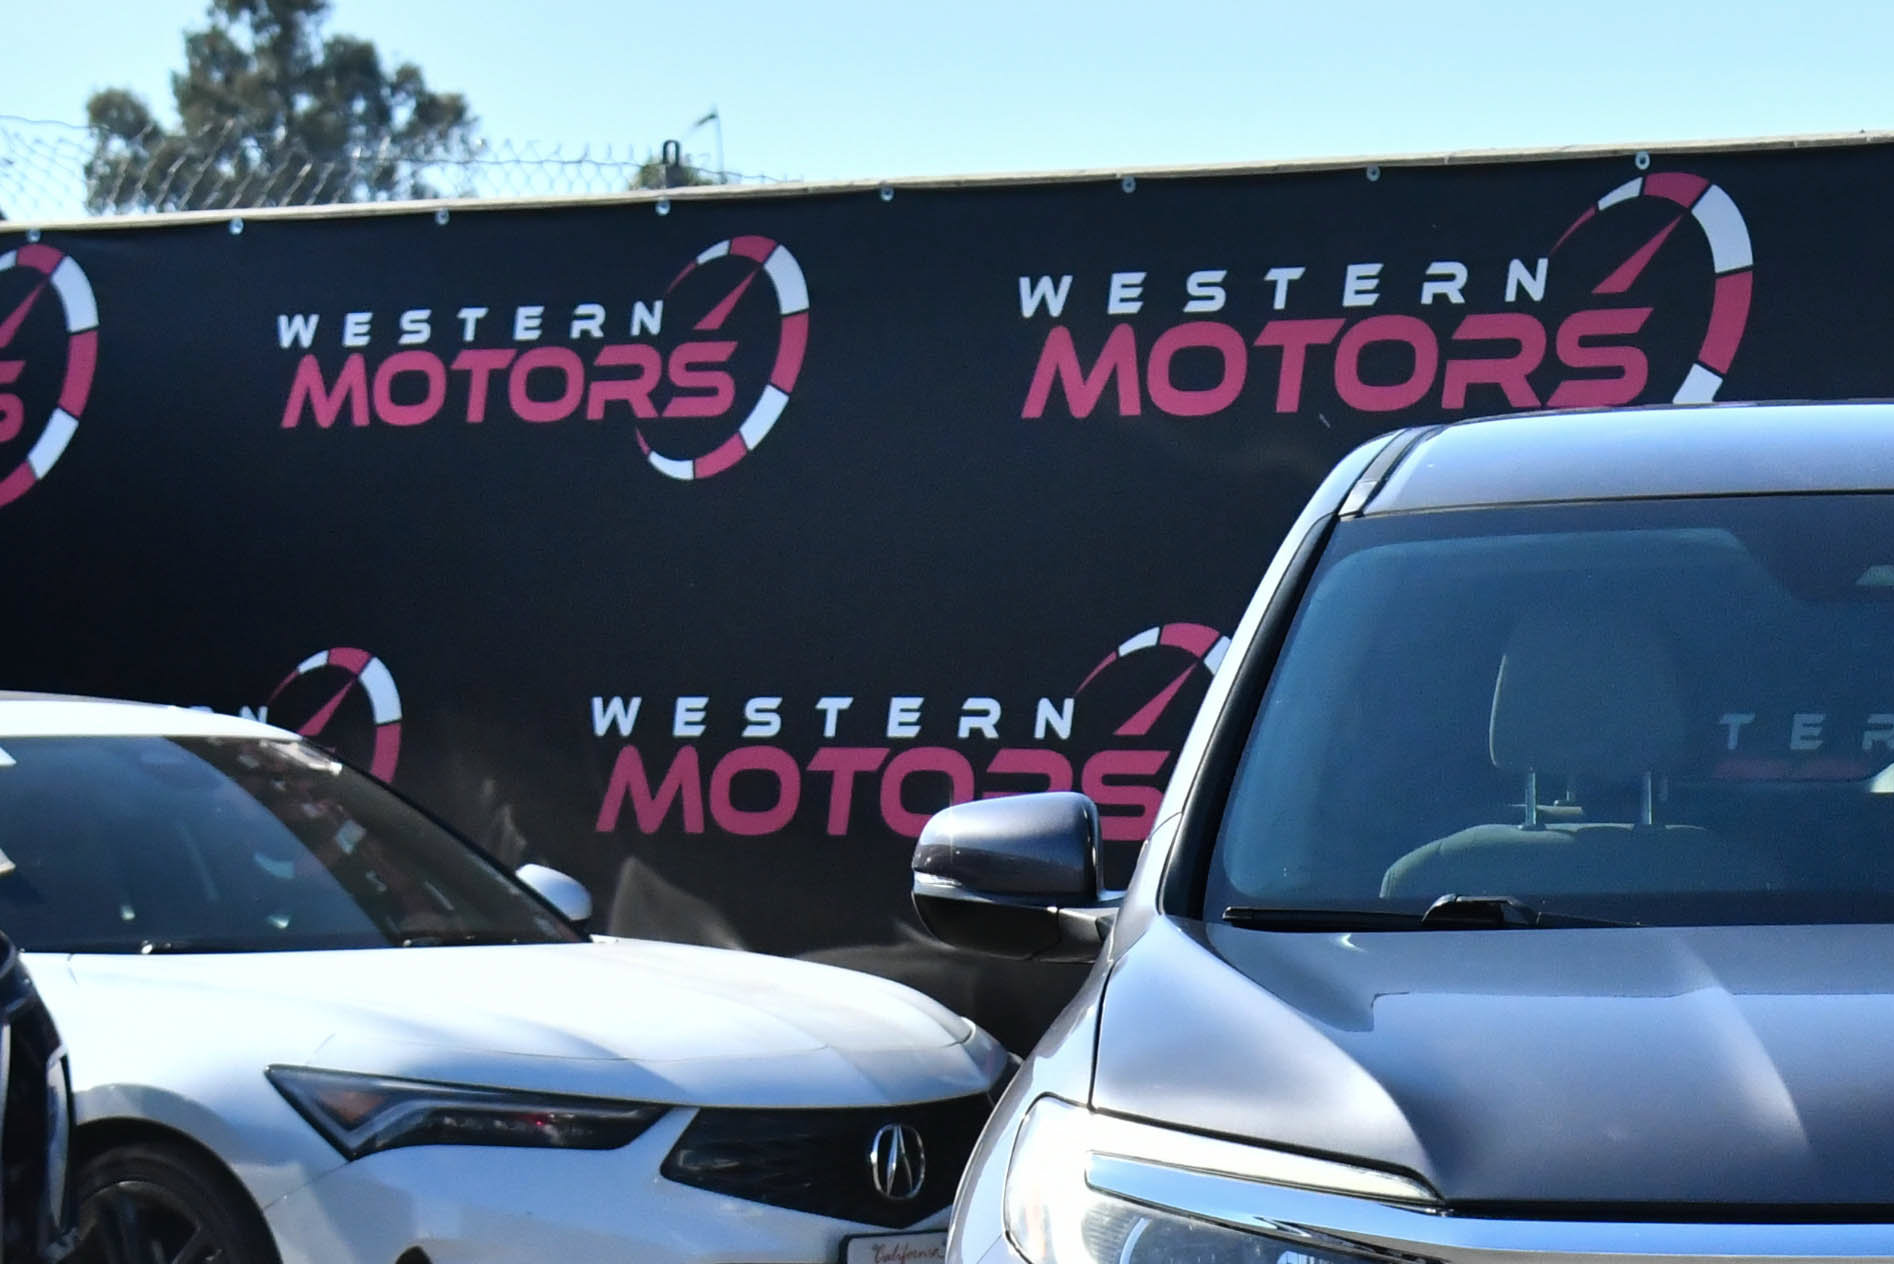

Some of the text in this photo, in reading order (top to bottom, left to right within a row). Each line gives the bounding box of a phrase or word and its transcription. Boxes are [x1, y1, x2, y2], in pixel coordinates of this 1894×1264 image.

[1018, 257, 1548, 318] WESTERN
[277, 300, 664, 348] WESTERN
[280, 340, 738, 430] MOTORS
[1020, 306, 1655, 420] MOTORS
[592, 696, 1074, 739] WESTERN
